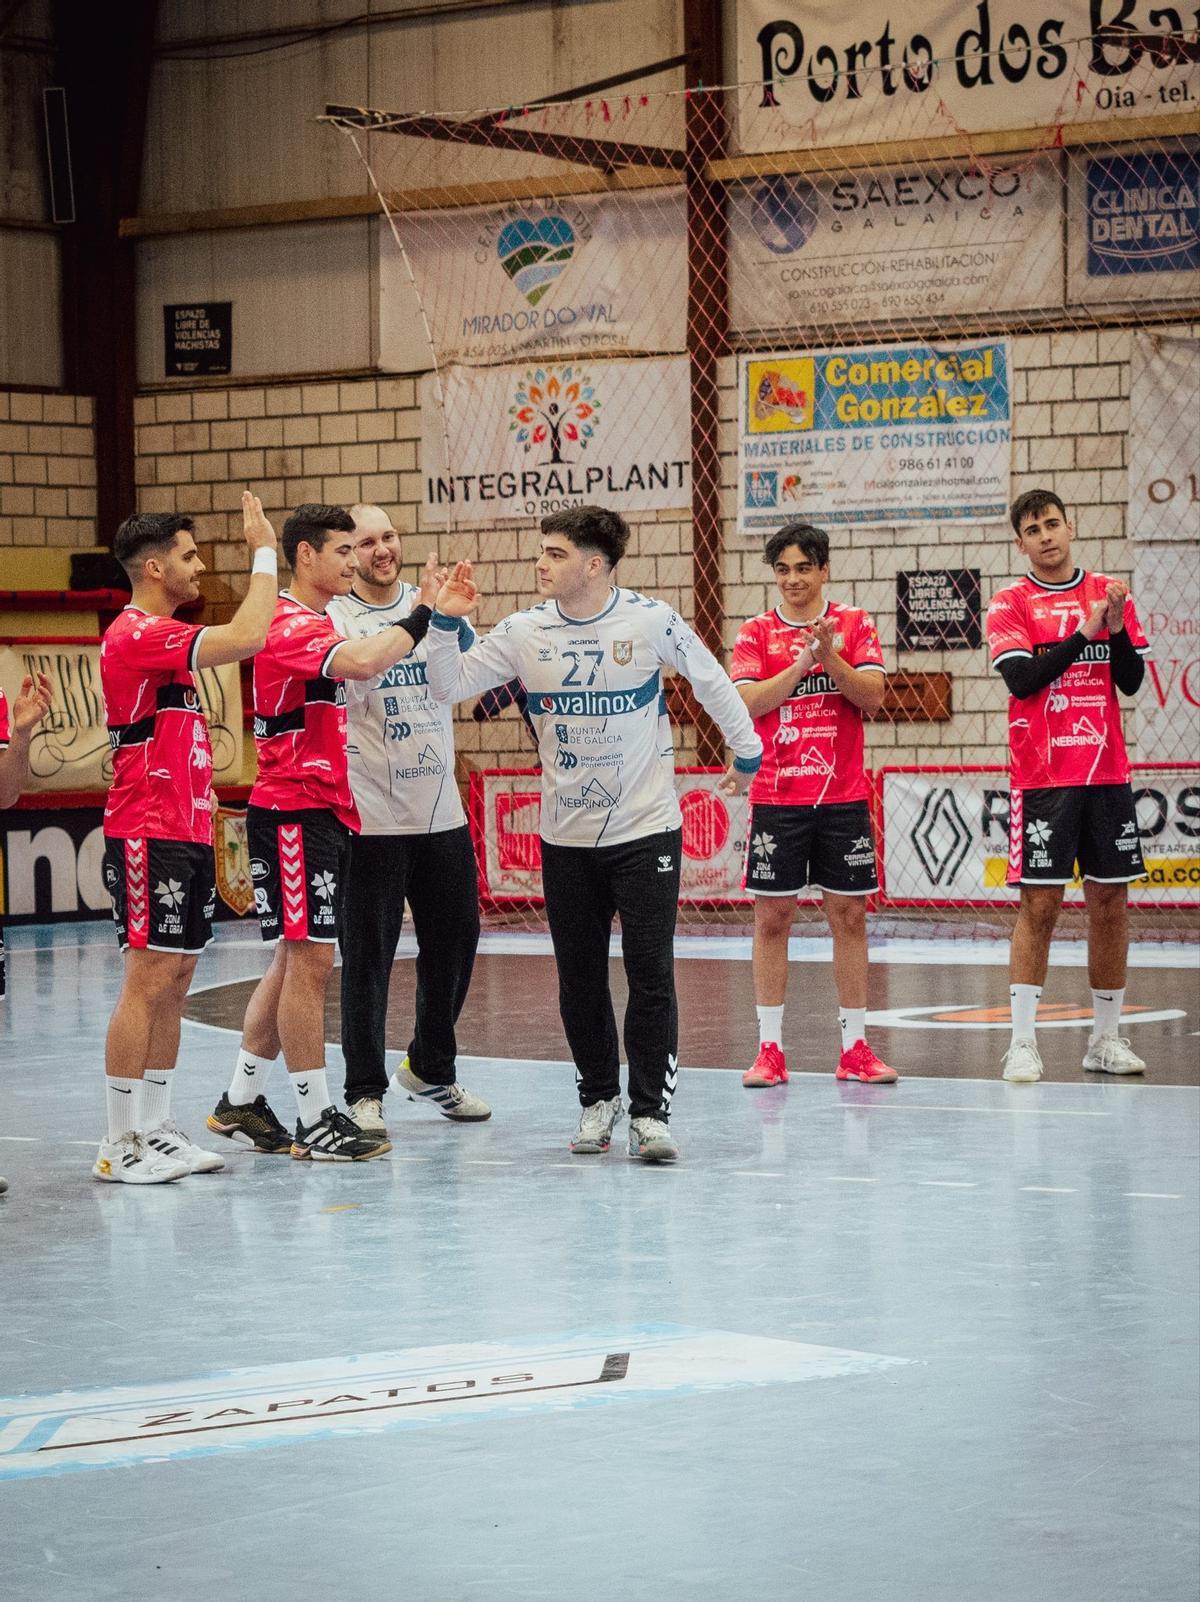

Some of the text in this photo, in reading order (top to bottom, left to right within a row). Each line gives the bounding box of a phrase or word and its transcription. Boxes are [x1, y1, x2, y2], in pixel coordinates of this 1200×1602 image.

[757, 0, 1200, 108] Porto dos Ba
[1095, 86, 1136, 110] Oia
[1158, 80, 1196, 103] tel.
[832, 168, 1022, 212] SAEXCO
[1092, 186, 1196, 214] CLINICA
[1092, 213, 1194, 241] DENTAL
[463, 310, 540, 336] MIRADOR
[543, 306, 577, 329] DO
[825, 350, 994, 387] Comercial
[836, 388, 989, 423] González
[744, 436, 847, 458] MATERIALES
[852, 437, 874, 451] DE
[900, 456, 974, 471] 986 61 41 00
[428, 461, 690, 503] INTEGRALPLANT
[525, 501, 536, 515] O
[909, 587, 953, 599] LIBRE DE
[908, 599, 967, 610] VIOLENCIAS
[909, 610, 965, 622] MACHISTAS
[561, 650, 604, 687] 27
[1073, 678, 1105, 687] GALICIA
[559, 692, 637, 715] valinox
[805, 709, 837, 719] GALICIA
[570, 727, 602, 736] XUNTA
[570, 735, 623, 745] DE GALICIA
[1052, 736, 1107, 748] NEBRINOX
[559, 796, 620, 809] NEBRINOX
[165, 914, 180, 924] ZONA
[320, 905, 333, 915] ZONA
[138, 1373, 535, 1428] ZAPATOS
